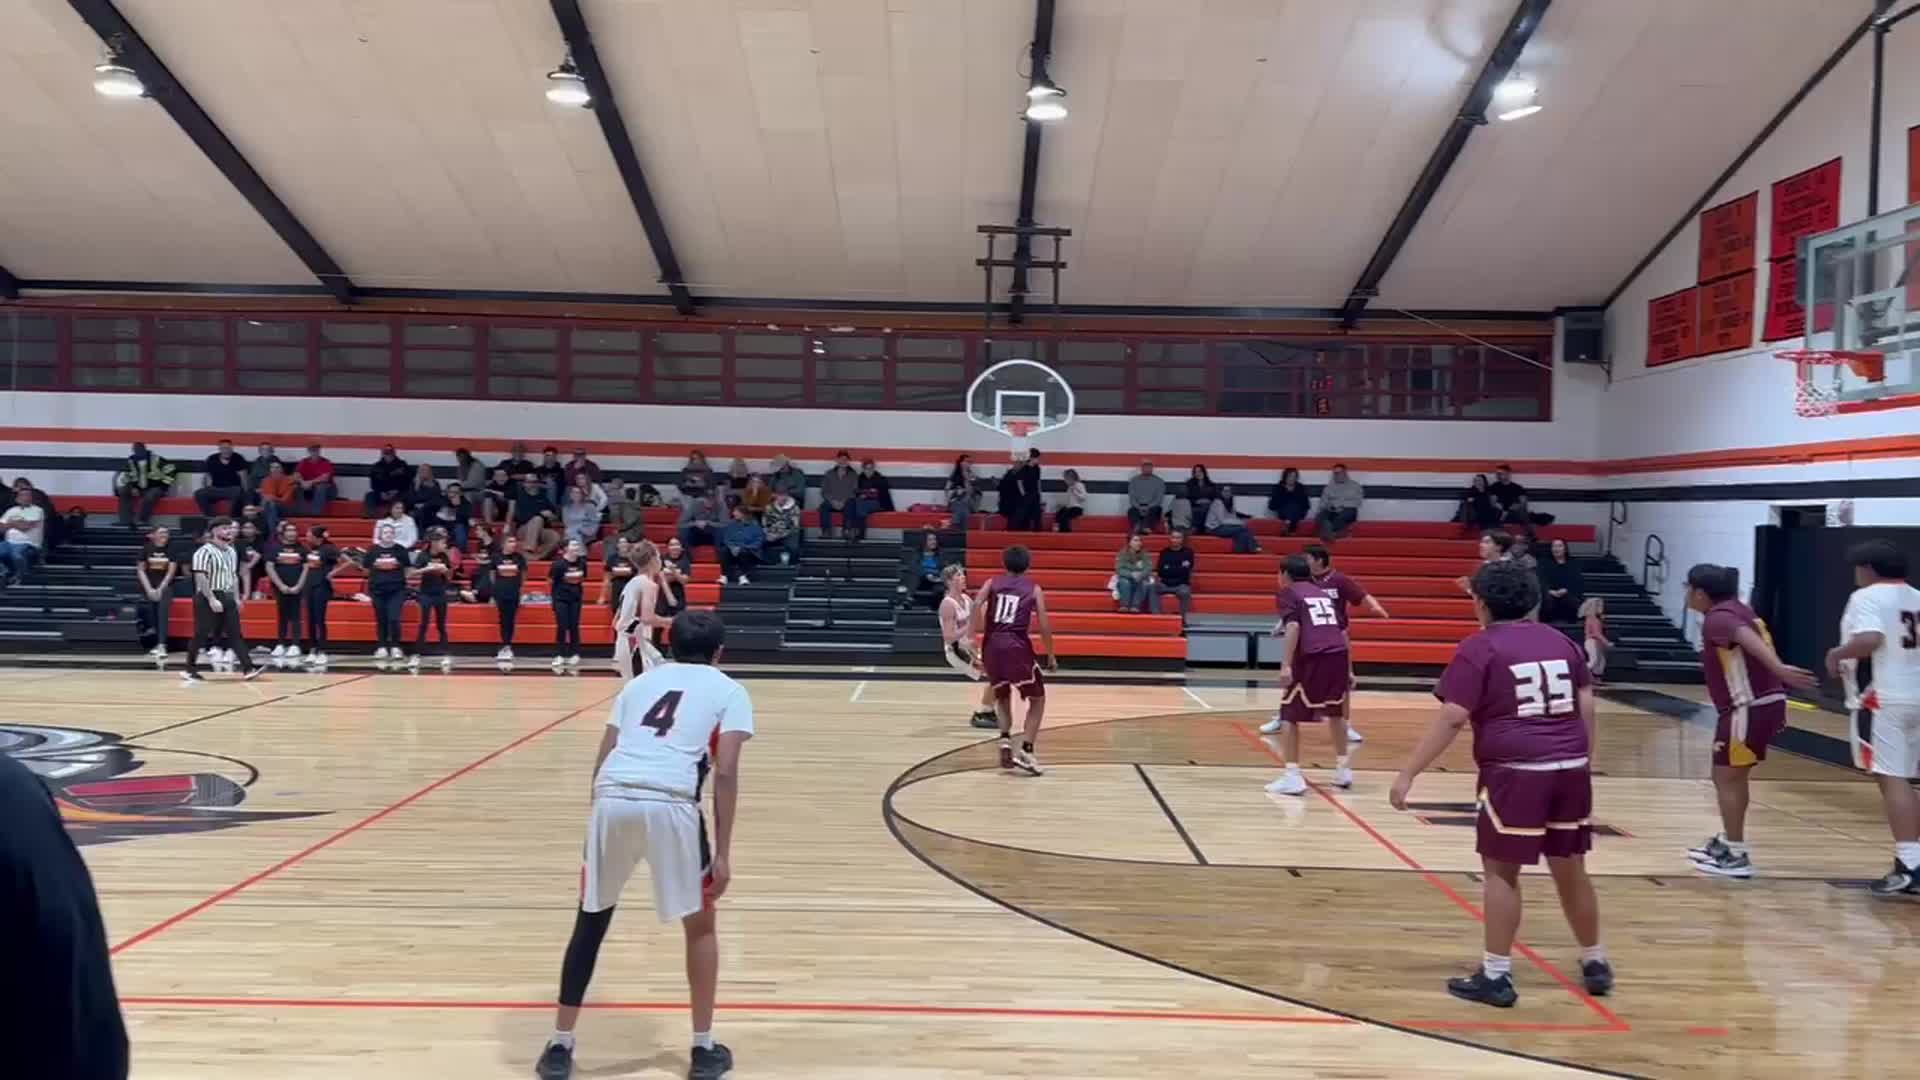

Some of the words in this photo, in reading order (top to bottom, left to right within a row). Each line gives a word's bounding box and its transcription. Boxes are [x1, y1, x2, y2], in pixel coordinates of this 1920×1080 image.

[993, 593, 1021, 624] 10
[1303, 597, 1338, 626] 25
[1899, 610, 1920, 649] 3
[1508, 659, 1575, 717] 35
[640, 690, 684, 737] 4
